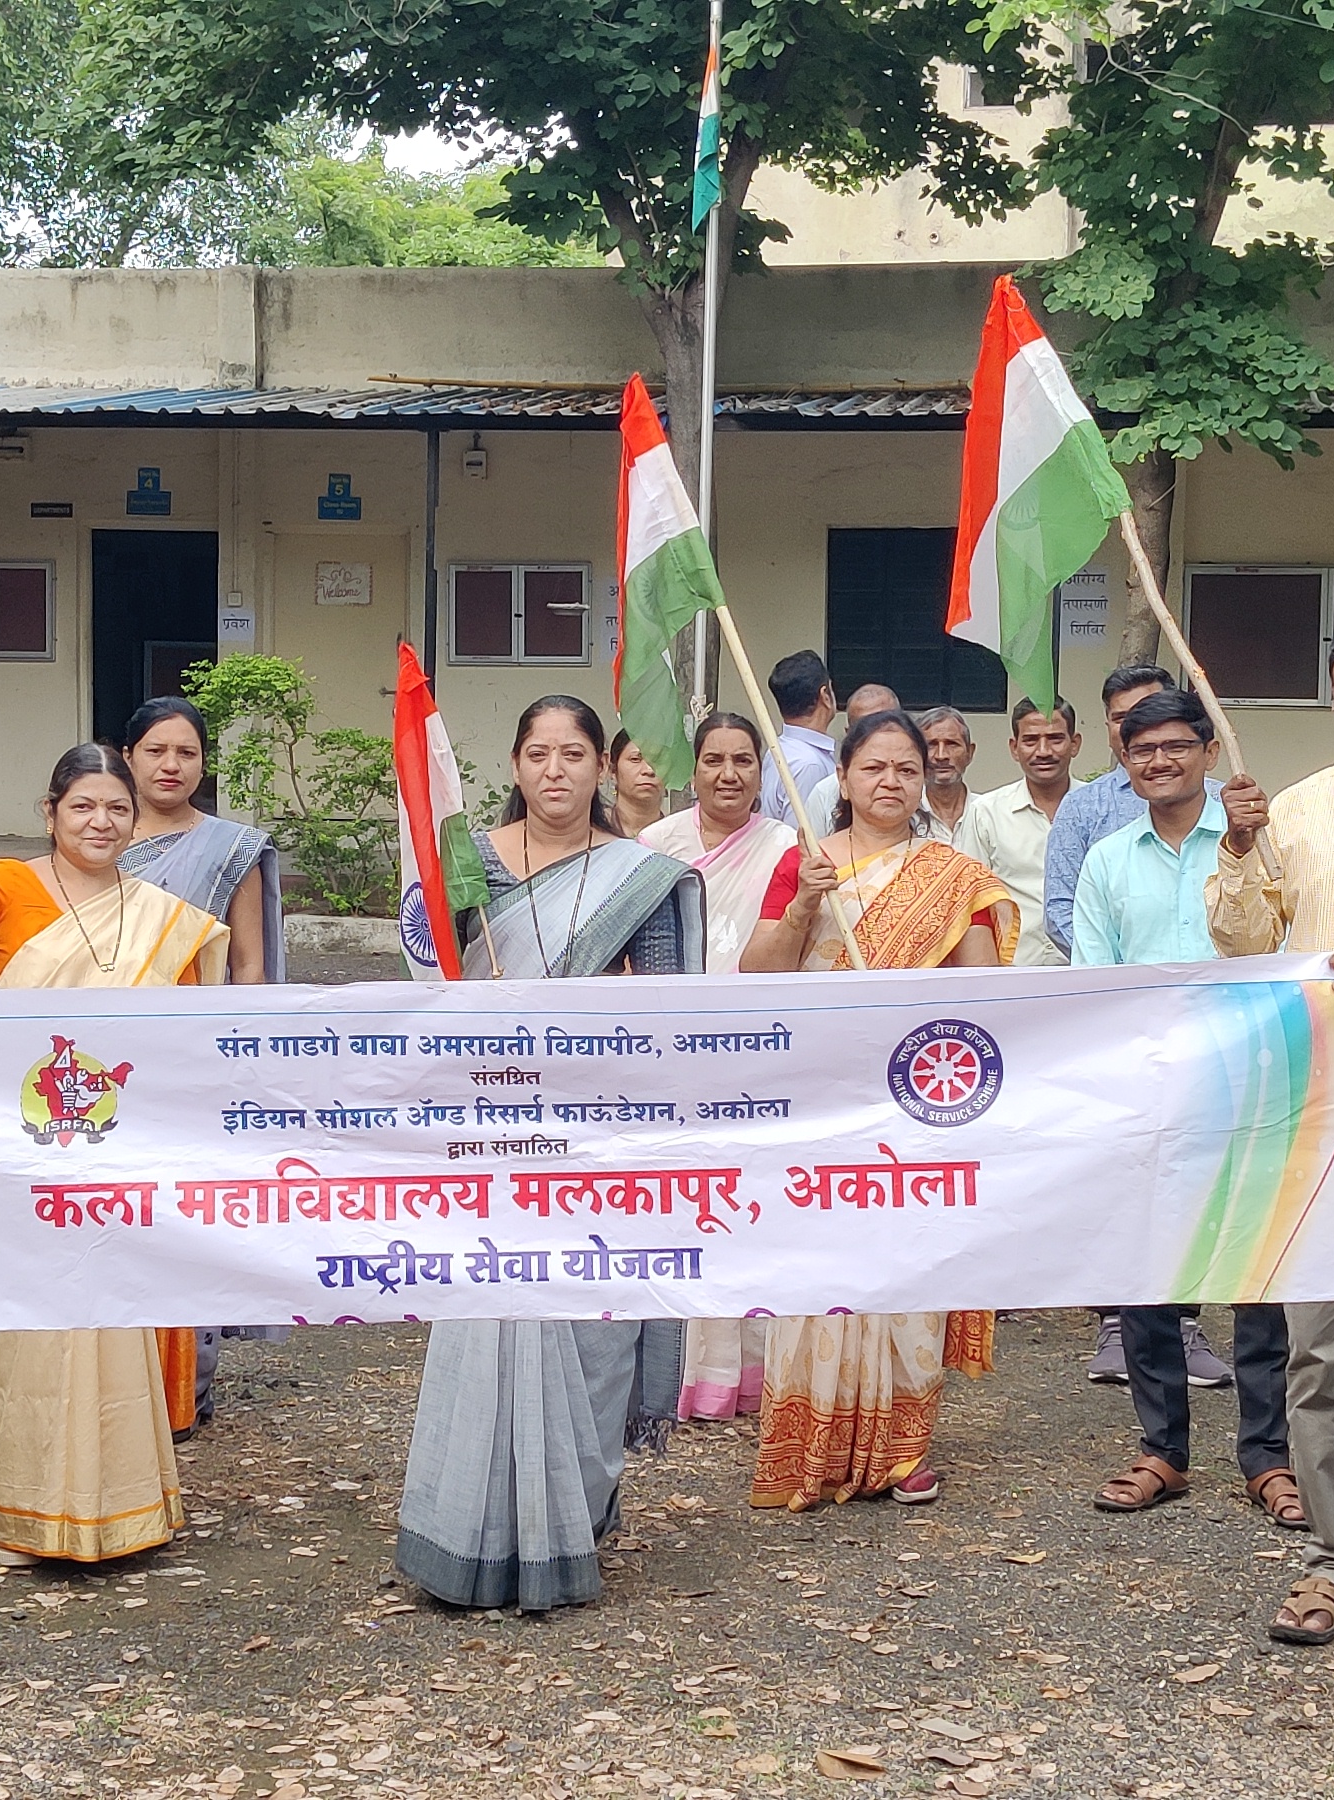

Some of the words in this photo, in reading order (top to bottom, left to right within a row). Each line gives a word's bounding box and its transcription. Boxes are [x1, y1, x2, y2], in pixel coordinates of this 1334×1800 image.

[144, 478, 153, 489] 4
[334, 484, 344, 496] 5
[319, 584, 361, 600] Welcome
[1063, 595, 1108, 610] तपासणी
[216, 1027, 261, 1058] संत
[268, 1026, 340, 1057] गाडगे
[348, 1034, 409, 1056] बाबा
[417, 1025, 536, 1057] अमरावती
[544, 1025, 663, 1059] विद्यापीठ,
[672, 1022, 793, 1053] अमरावती
[896, 1031, 929, 1064] राष्ट्रीय
[963, 1027, 995, 1059] योजना
[892, 1073, 925, 1117] NATIONAL
[927, 1105, 975, 1122] SERVICE
[972, 1068, 998, 1110] SCHEME
[45, 1119, 94, 1133] ISRFA
[222, 1100, 308, 1135] इंडियन
[316, 1100, 398, 1129] सोशल
[474, 1094, 545, 1126] रिसर्च
[552, 1094, 686, 1127] फाऊंडेशन,
[695, 1091, 791, 1121] अकोला
[447, 1140, 485, 1160] द्वारा
[490, 1132, 570, 1156] संचालित
[31, 1181, 158, 1227] कला
[175, 1157, 494, 1228] महाविद्यालय
[509, 1166, 761, 1235] मलकापूर,
[783, 1142, 982, 1210] अकोला
[315, 1239, 455, 1295] राष्ट्रीय
[464, 1236, 551, 1285] सेवा
[562, 1234, 703, 1282] योजना
